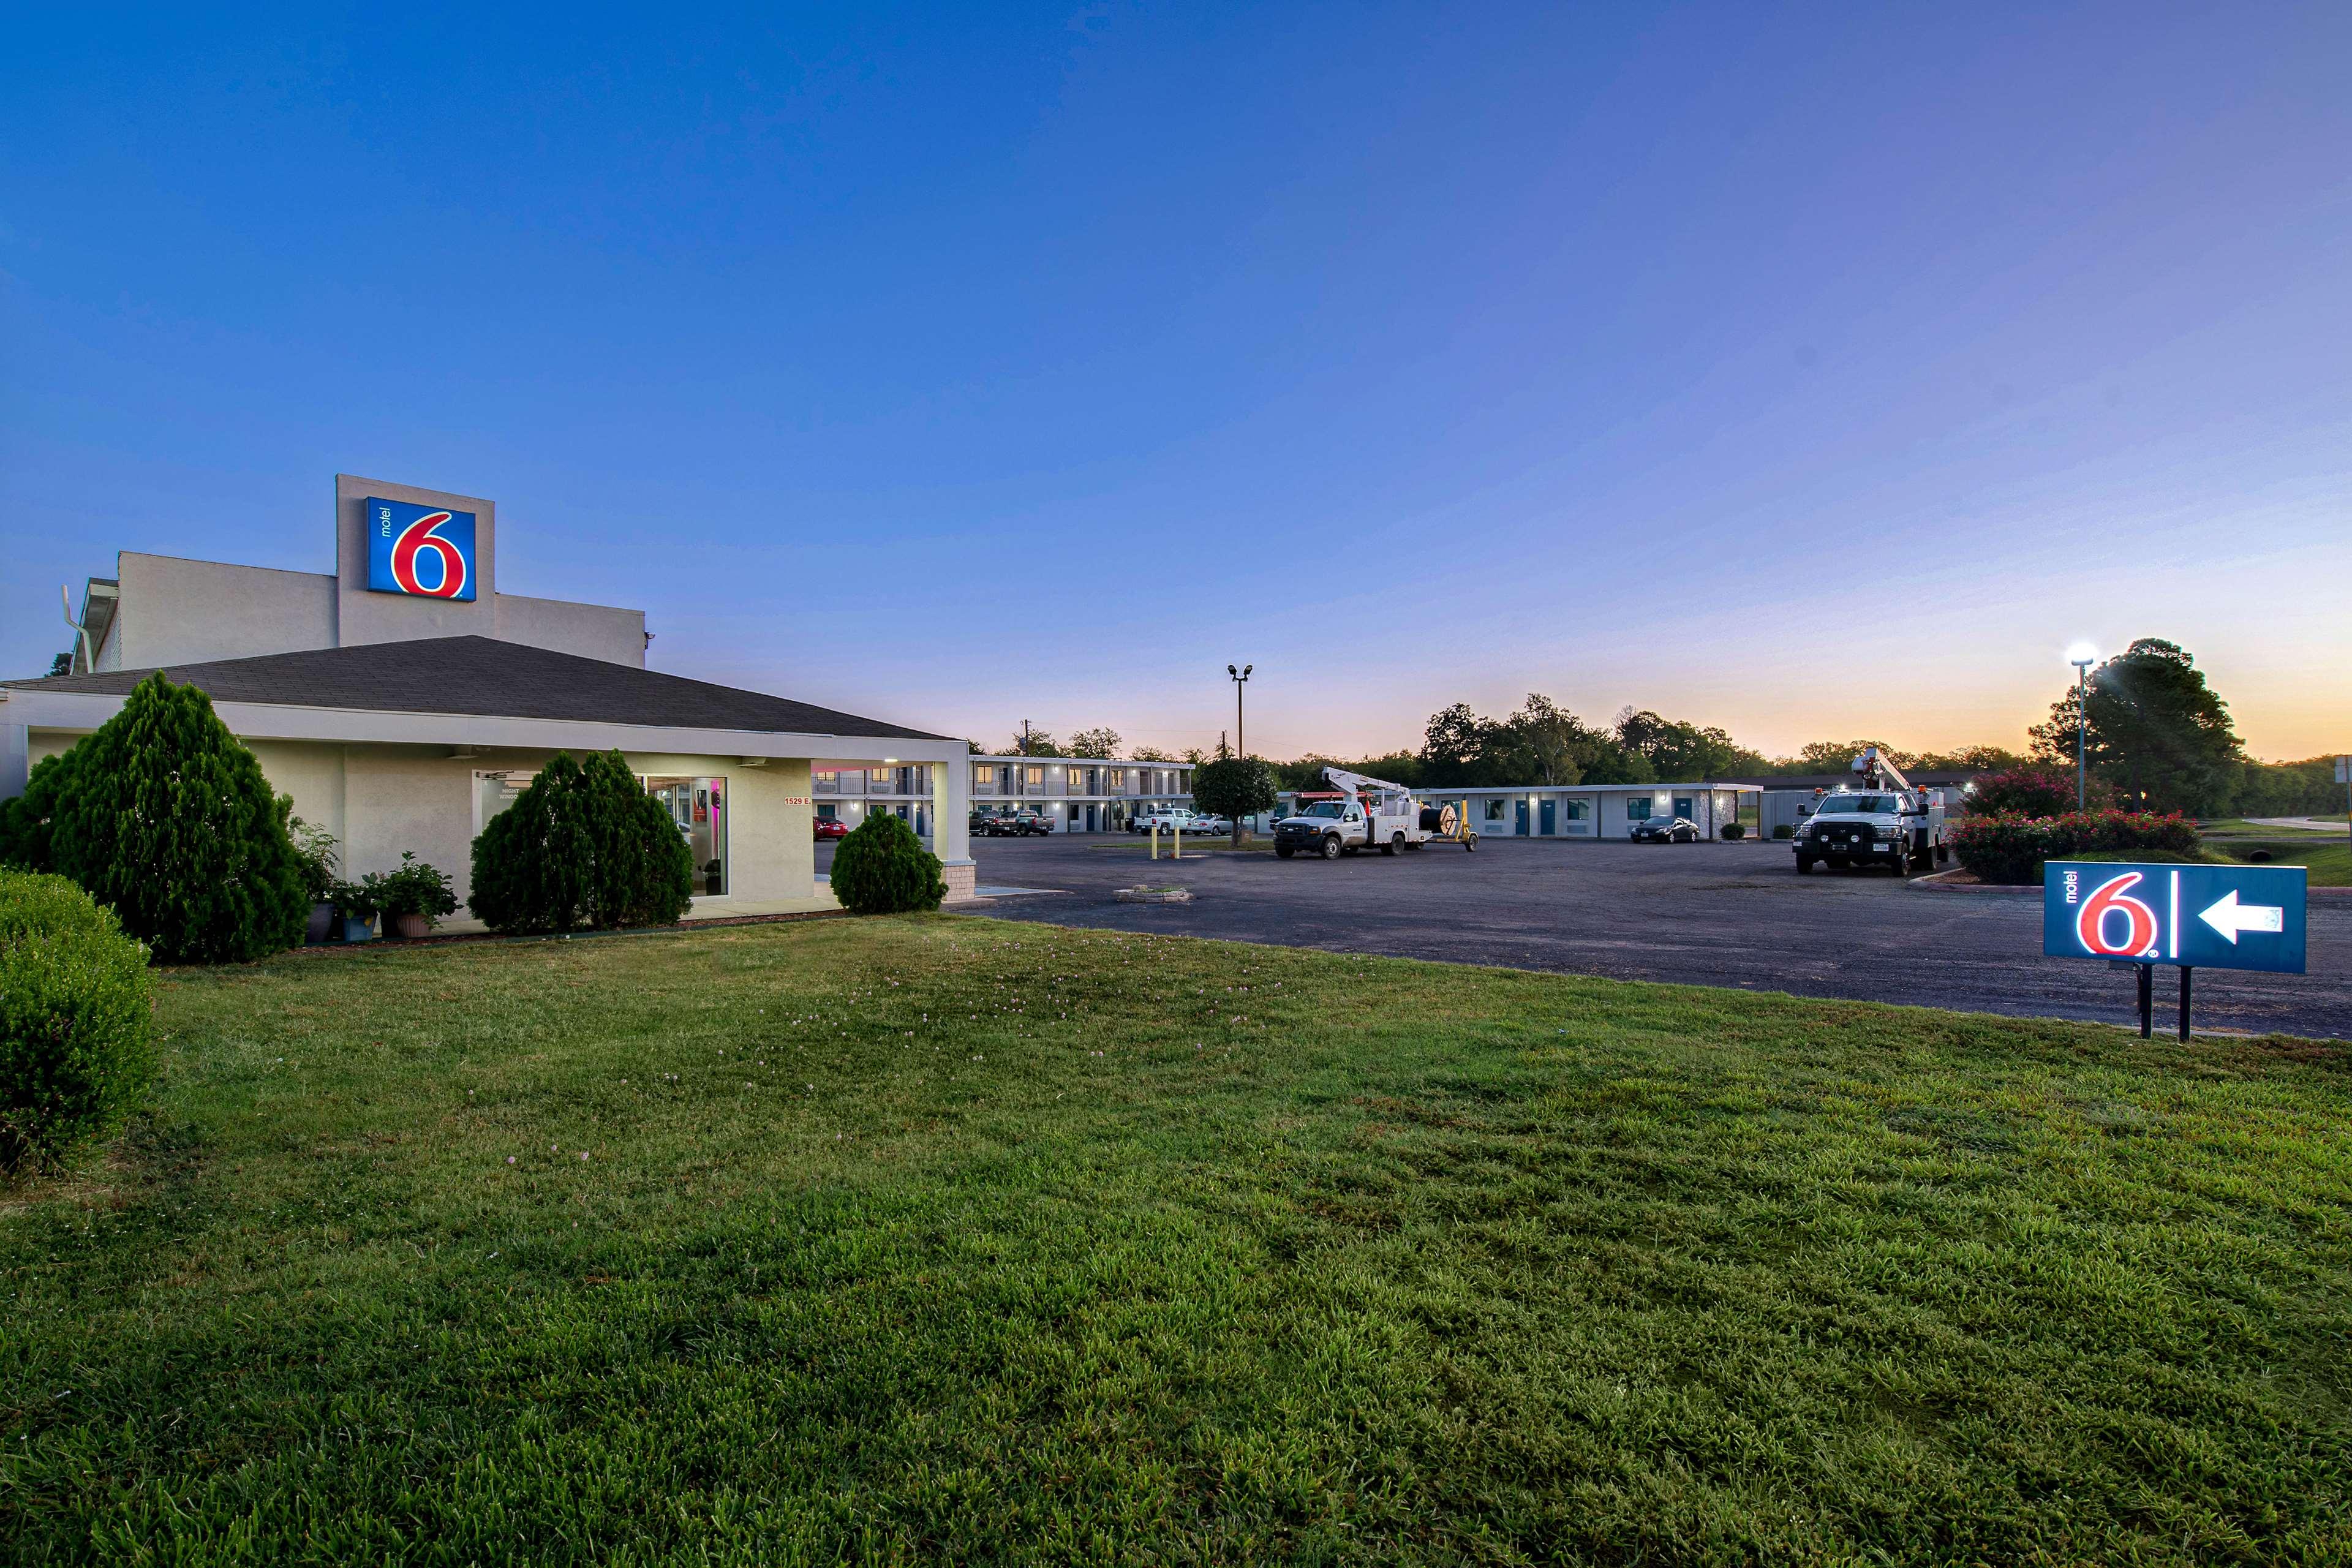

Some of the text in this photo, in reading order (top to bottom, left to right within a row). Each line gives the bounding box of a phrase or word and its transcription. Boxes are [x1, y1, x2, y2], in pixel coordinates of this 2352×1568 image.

[379, 507, 467, 598] motel 6
[2063, 870, 2158, 957] motel 6
